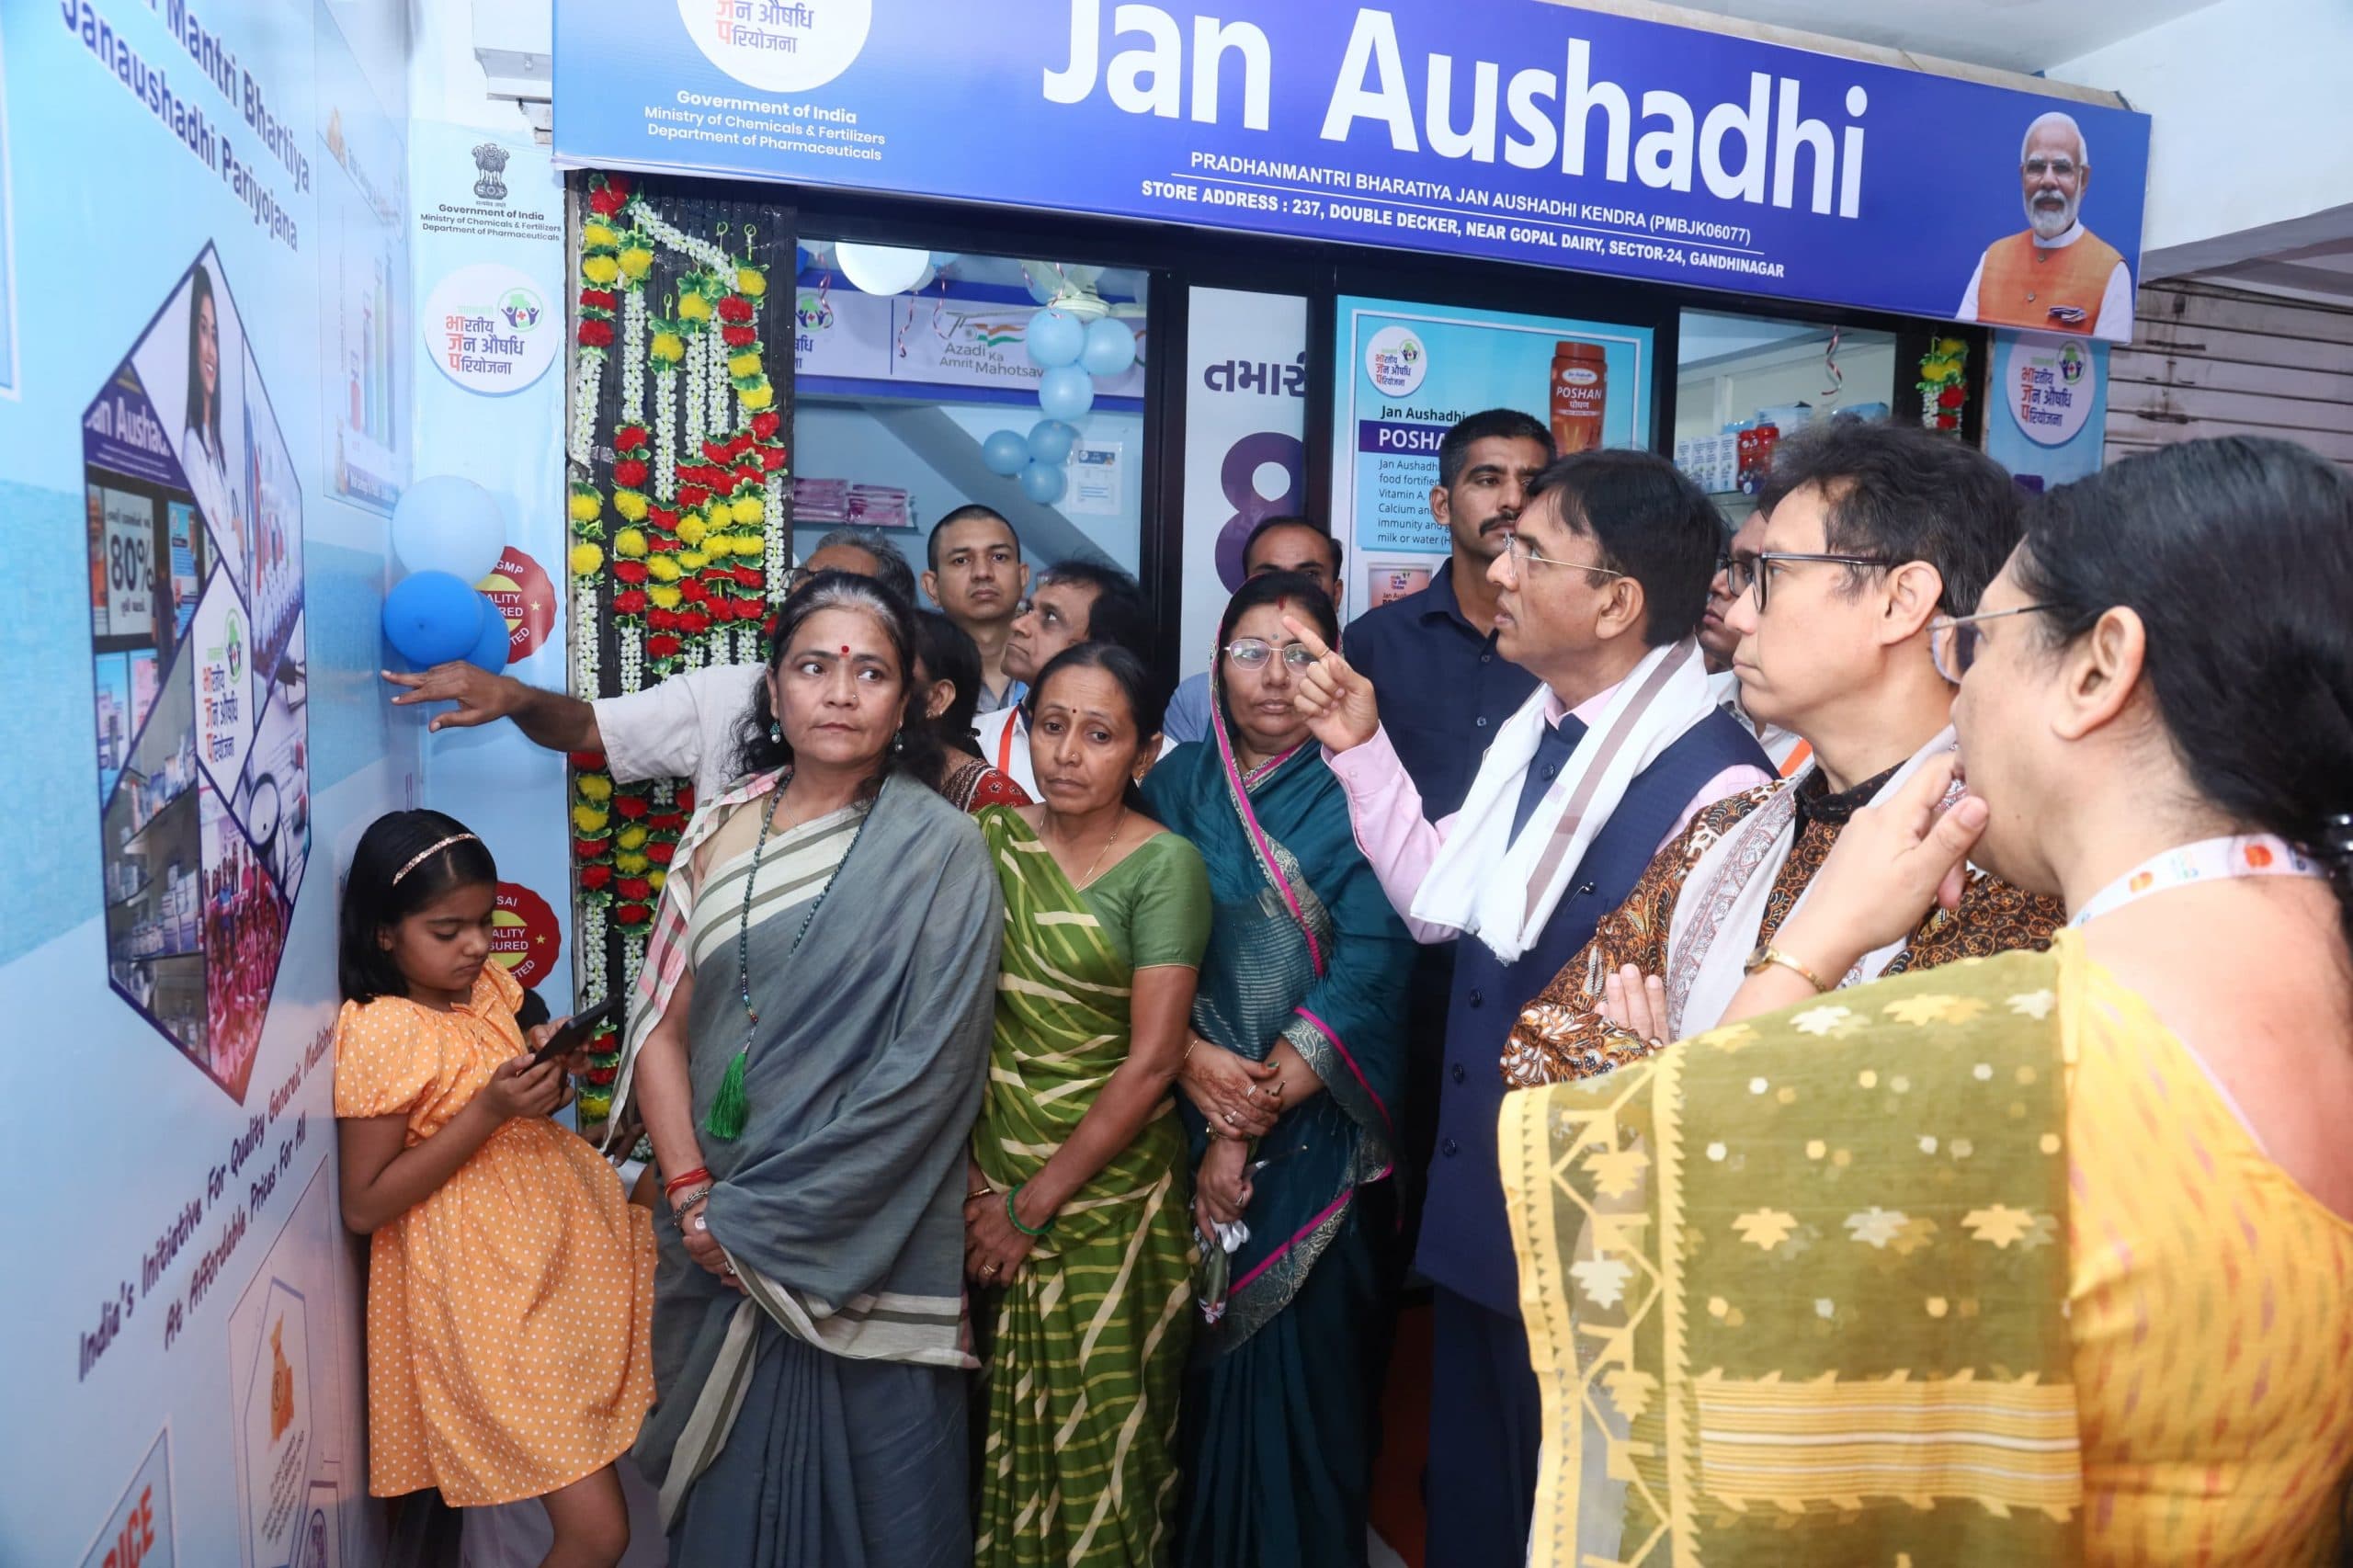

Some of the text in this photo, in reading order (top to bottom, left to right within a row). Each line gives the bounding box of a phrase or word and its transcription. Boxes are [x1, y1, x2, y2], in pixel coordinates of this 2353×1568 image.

[716, 19, 798, 53] परियोजना
[676, 90, 857, 124] Government of India
[1043, 0, 1868, 219] Jan Aushadhi
[244, 70, 310, 194] Bhartiya
[644, 106, 886, 145] Ministry of Chemicals & Fertilizers
[648, 123, 882, 161] Department of Pharmaceuticals
[222, 135, 298, 252] Pariyojana
[1191, 152, 1751, 246] PRADHANMANTRI BHARATIYA JAN AUSHADHI KENDRA (PMBJK06077)
[420, 214, 455, 224] Ministry
[467, 218, 513, 228] Chemicals
[522, 223, 562, 232] Fertilizers
[438, 204, 505, 218] Government
[518, 211, 544, 221] India
[423, 223, 560, 241] Department of Pharmaceuticals
[1142, 180, 1197, 201] STORE
[1202, 187, 1279, 211] ADDRESS
[1292, 199, 1324, 220] 237,
[1330, 203, 1392, 226] DOUBLE
[1397, 212, 1461, 237] DECKER,
[1466, 220, 1506, 240] NEAR
[1510, 226, 1557, 247] GOPAL
[1562, 233, 1606, 256] DAIRY,
[1608, 240, 1687, 267] SECTOR-24,
[1689, 252, 1785, 278] GANDHINAGAR
[446, 315, 494, 334] भारतीय
[446, 334, 525, 356] जन औषधि
[945, 342, 1005, 362] Azadi Ka
[449, 352, 512, 375] परियोजना
[939, 356, 1044, 378] Amrit Mahotsav
[2020, 367, 2054, 384] भारतीय
[1556, 385, 1603, 400] POSHAN
[2043, 386, 2072, 408] औषधि
[1381, 405, 1402, 419] Jan
[2020, 403, 2063, 426] परियोजना
[1379, 460, 1438, 471] Jan Aushadh
[1379, 472, 1401, 483] food
[1379, 488, 1415, 499] Vitamin
[1378, 503, 1415, 514] Calcium
[1378, 533, 1397, 542] milk
[1400, 535, 1410, 543] or
[1413, 536, 1438, 544] water
[110, 533, 155, 594] 80%
[493, 928, 526, 938] ALITY
[78, 1280, 134, 1382] India's
[142, 1198, 202, 1299] Initiative
[208, 1164, 226, 1210] For
[231, 1113, 265, 1178] Quality
[304, 1021, 335, 1079] Medicines
[165, 1109, 306, 1352] At Affordable Prices For All
